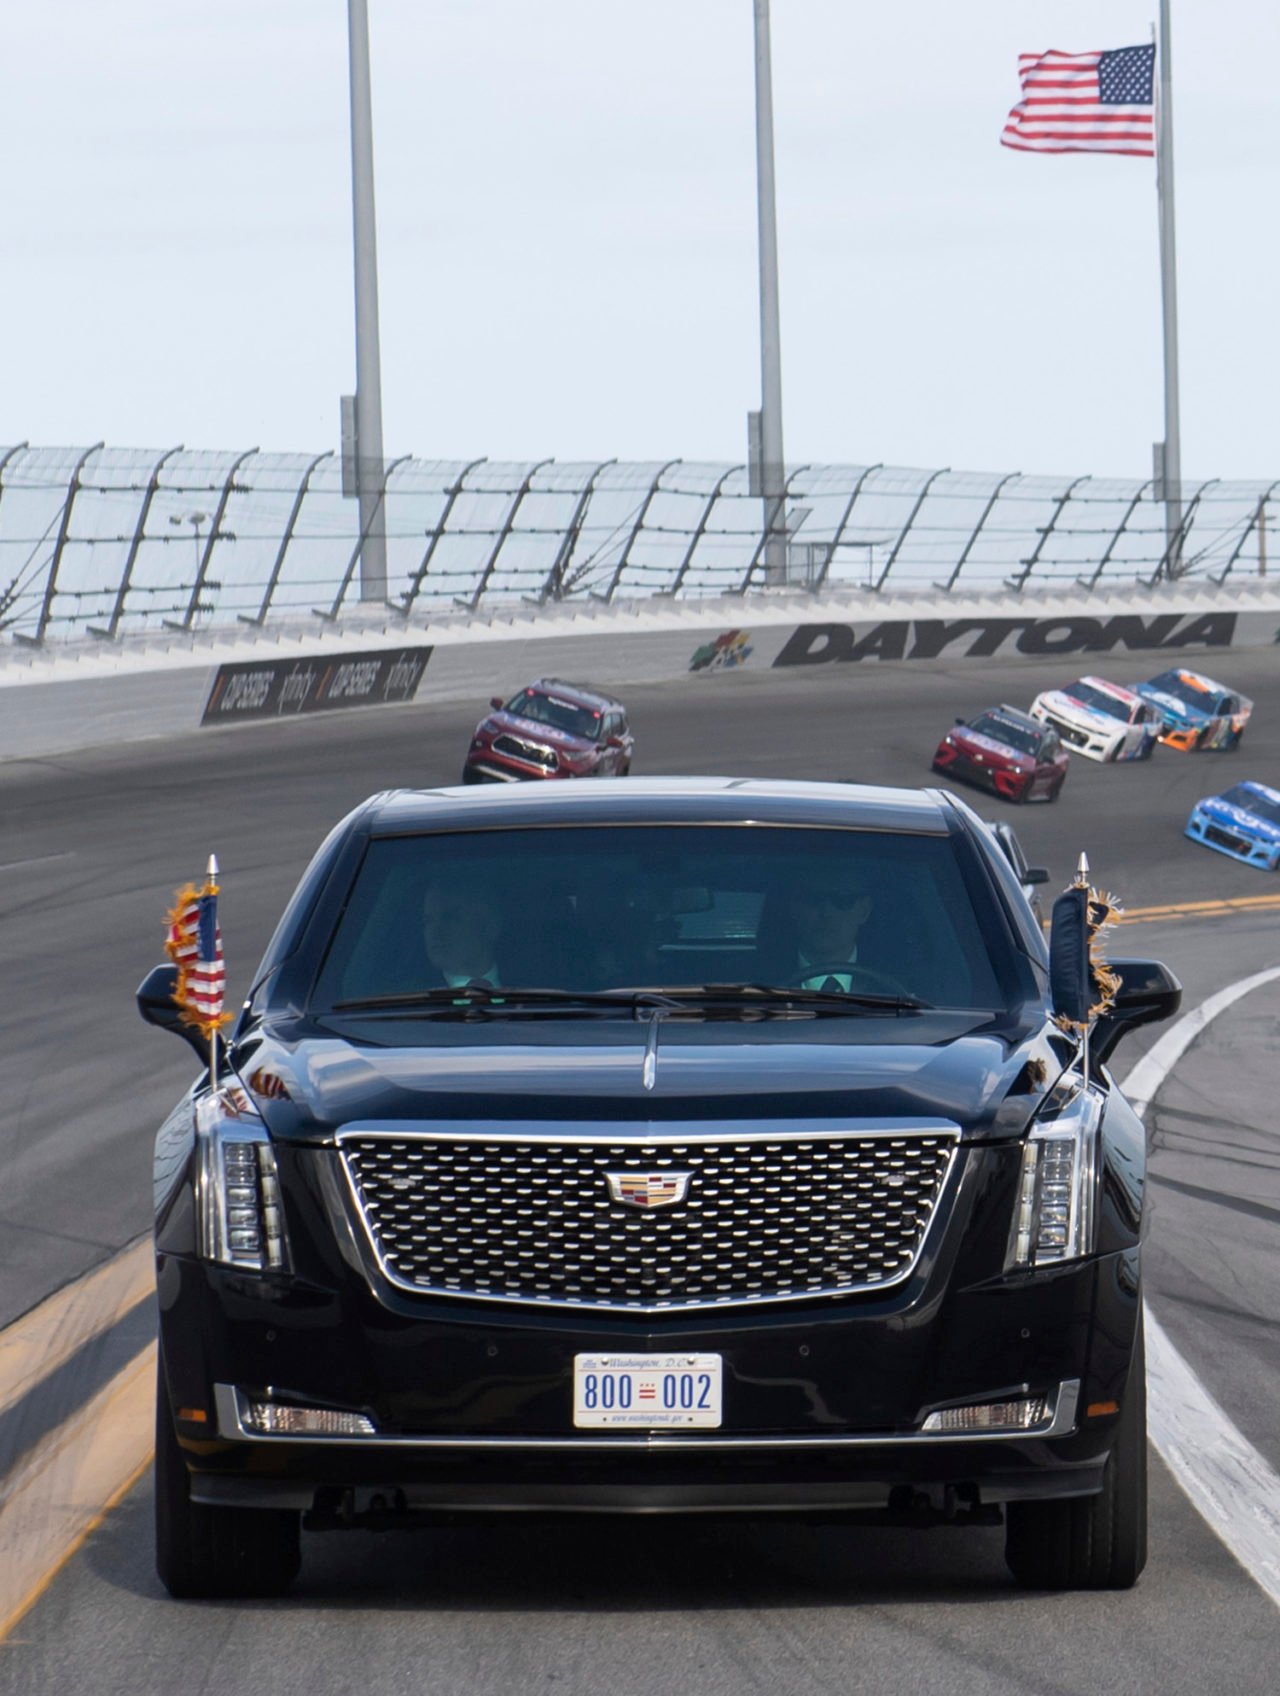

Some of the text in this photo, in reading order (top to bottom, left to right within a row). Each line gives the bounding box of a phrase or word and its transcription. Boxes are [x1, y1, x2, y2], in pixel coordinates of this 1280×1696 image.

[772, 612, 1238, 668] DAYTONA
[585, 1374, 711, 1409] 800 002
